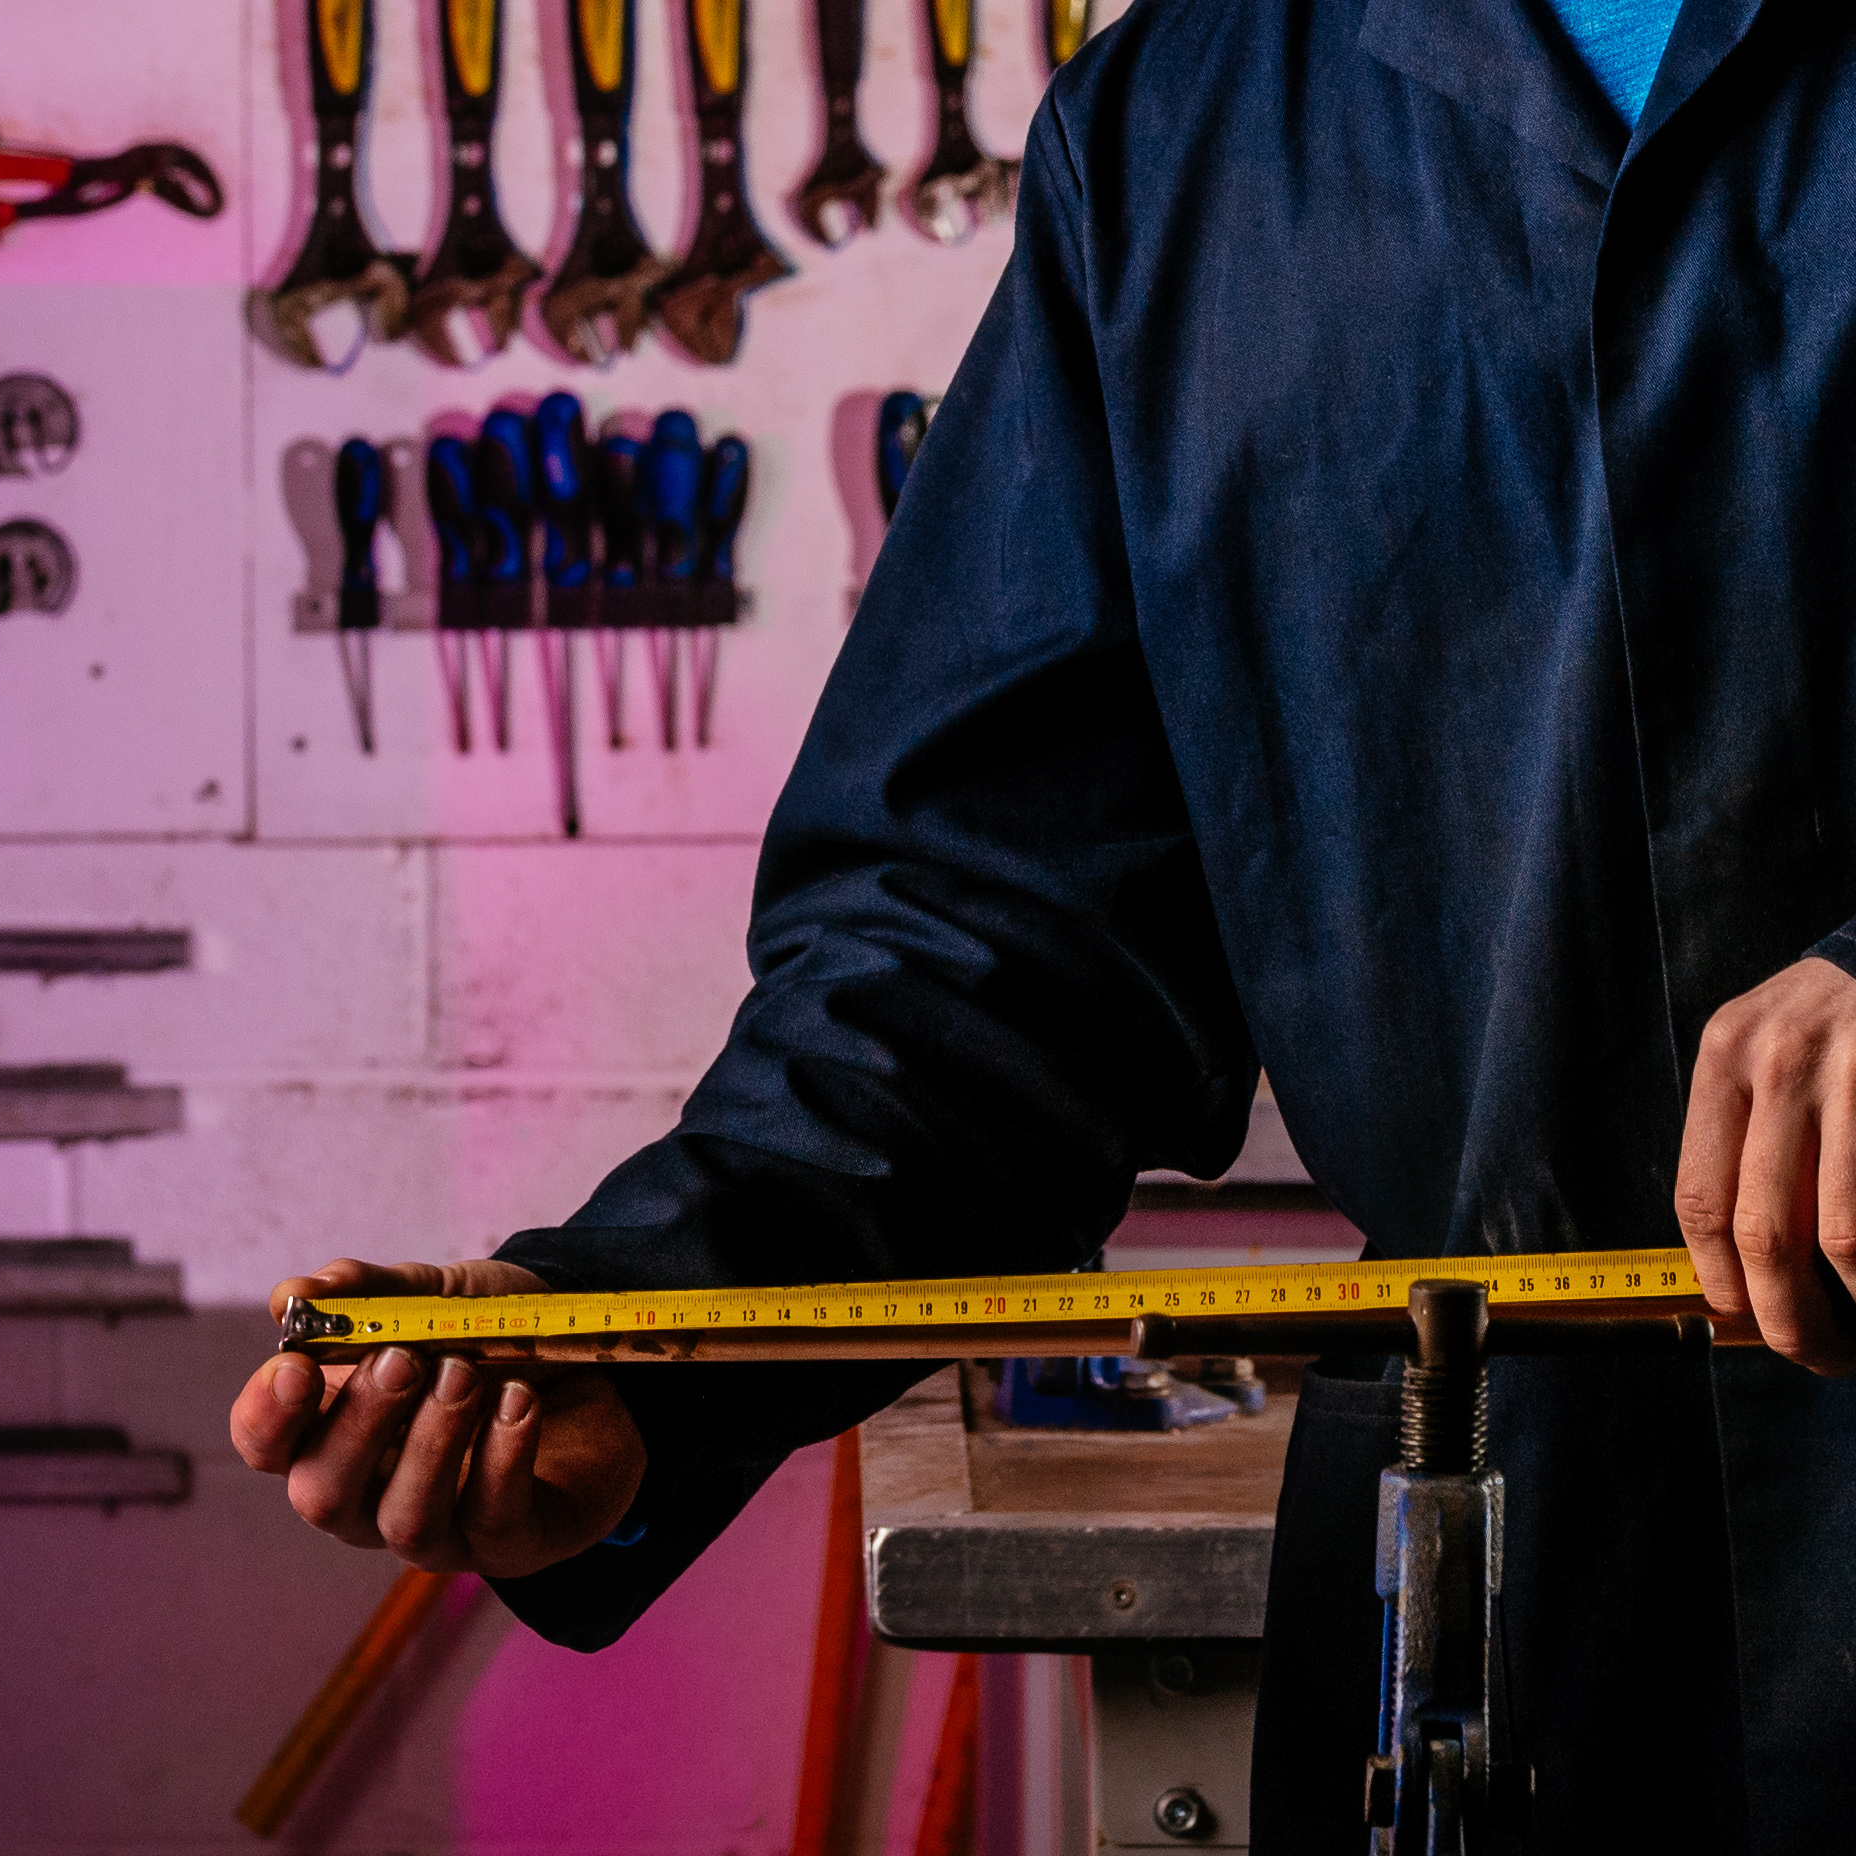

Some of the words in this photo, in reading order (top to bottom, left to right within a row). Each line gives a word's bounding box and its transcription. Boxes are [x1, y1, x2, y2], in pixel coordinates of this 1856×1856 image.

[357, 1320, 365, 1334] 2
[393, 1320, 400, 1333] 3
[427, 1318, 434, 1332] 4
[463, 1318, 470, 1331] 5
[498, 1317, 505, 1330] 6
[533, 1316, 540, 1329] 7
[568, 1315, 576, 1328] 8
[604, 1314, 611, 1327] 9
[635, 1310, 656, 1326] 10
[672, 1312, 685, 1324] 11
[707, 1310, 721, 1323] 12
[742, 1310, 756, 1322] 13
[777, 1308, 791, 1321] 14
[813, 1307, 827, 1320] 15
[848, 1306, 863, 1319] 16
[884, 1304, 897, 1317] 17
[918, 1302, 933, 1316] 18
[954, 1301, 968, 1315] 19
[984, 1297, 1006, 1314] 20
[1023, 1298, 1037, 1313] 21
[1058, 1297, 1074, 1311] 22
[1094, 1295, 1110, 1310] 23
[1129, 1294, 1144, 1308] 24
[1164, 1292, 1180, 1307] 25
[1200, 1291, 1216, 1305] 26
[1235, 1290, 1250, 1304] 27
[1271, 1288, 1286, 1303] 28
[1306, 1286, 1322, 1301] 29
[1338, 1282, 1360, 1301] 30
[1376, 1284, 1391, 1299] 31
[1518, 1278, 1535, 1292] 35
[1554, 1276, 1570, 1291] 36
[1589, 1275, 1605, 1289] 37
[1625, 1273, 1641, 1288] 38
[1661, 1271, 1677, 1286] 39
